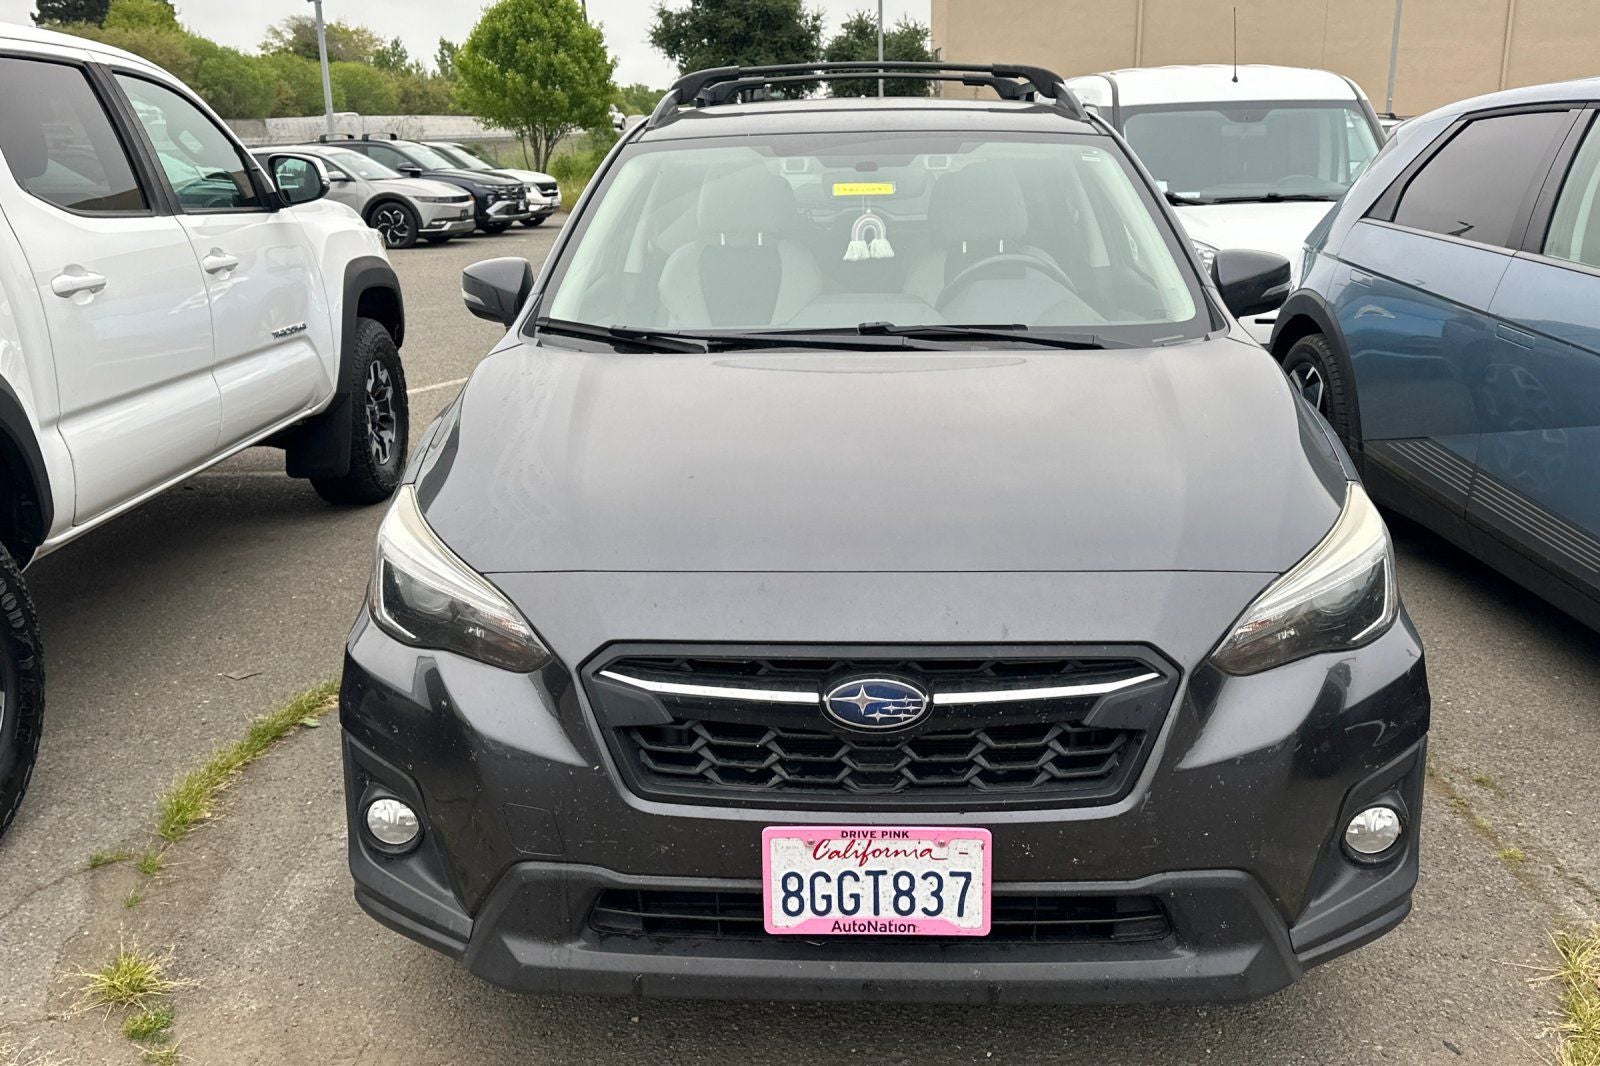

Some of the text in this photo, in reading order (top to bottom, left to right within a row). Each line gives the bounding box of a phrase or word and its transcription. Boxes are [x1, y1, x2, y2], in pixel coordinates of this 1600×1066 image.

[840, 830, 910, 839] DRIVE PINK
[812, 838, 948, 867] California
[781, 869, 972, 918] 8GGT837
[831, 920, 917, 933] AutoNation
